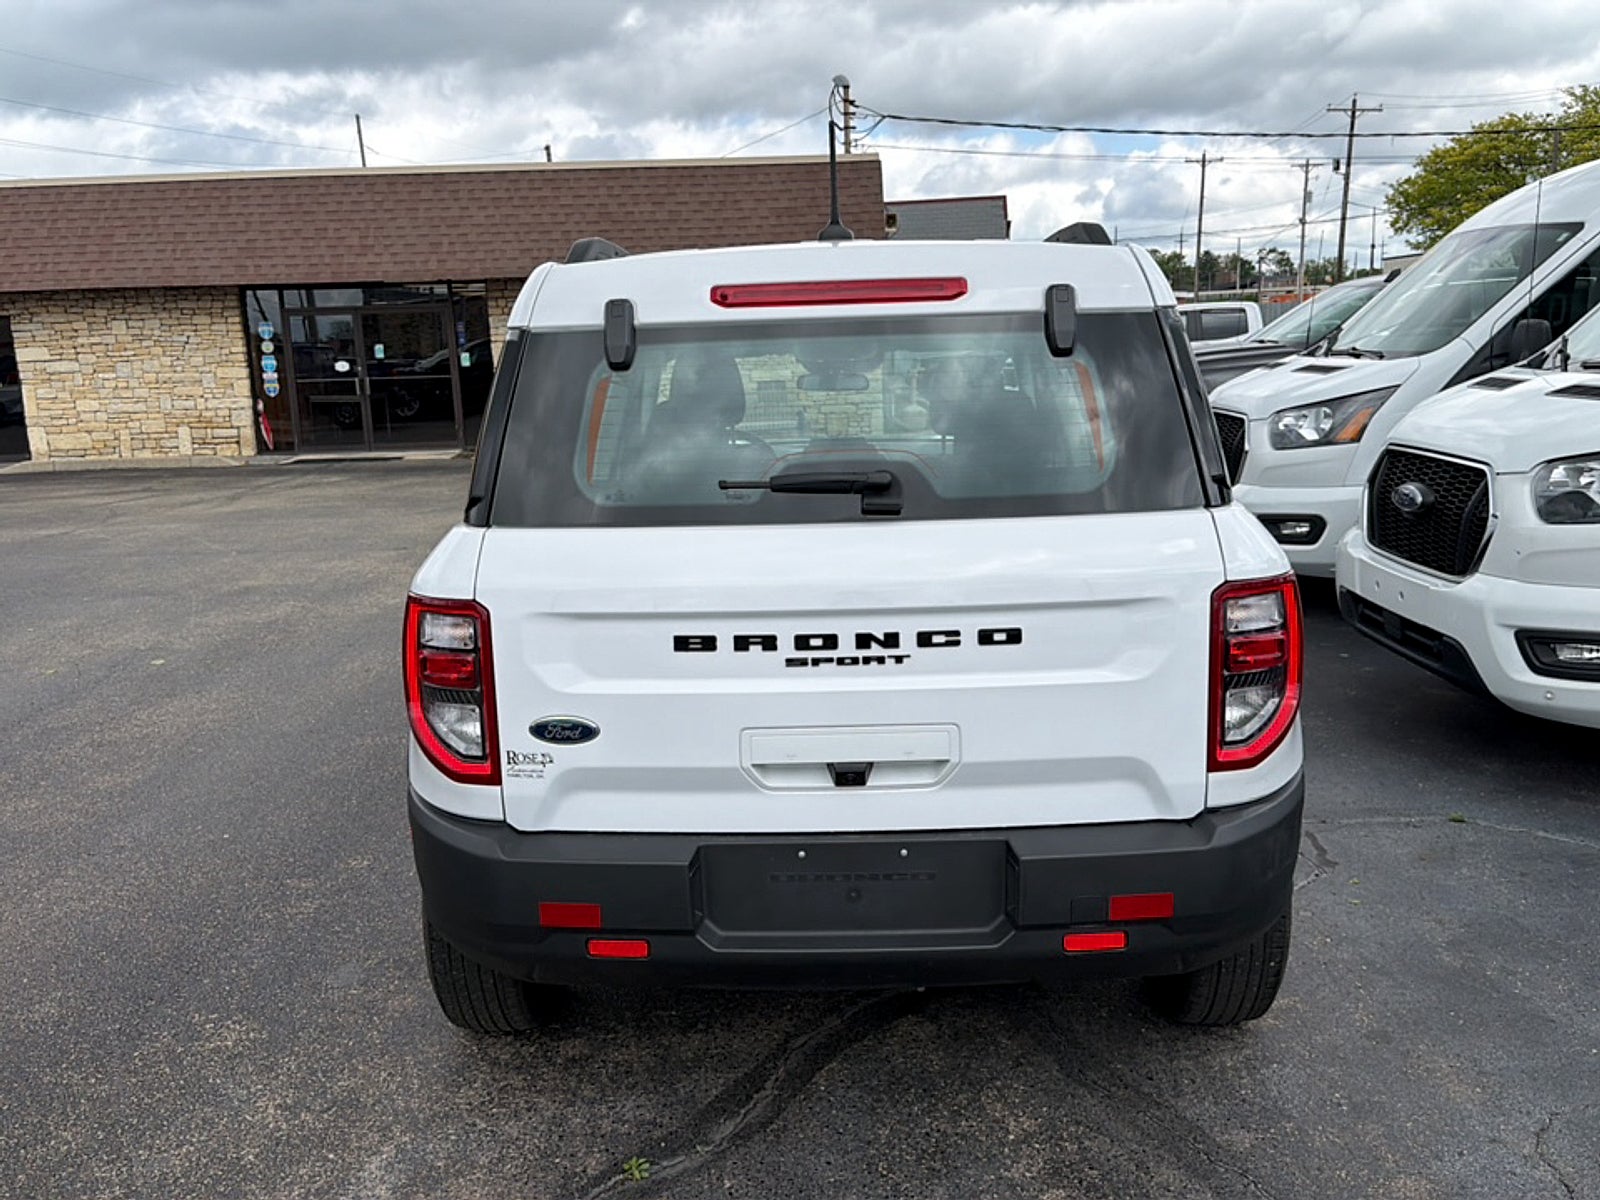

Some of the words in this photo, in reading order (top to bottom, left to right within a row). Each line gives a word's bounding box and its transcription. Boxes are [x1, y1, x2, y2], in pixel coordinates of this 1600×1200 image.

[673, 627, 1022, 652] BRONCO
[784, 654, 911, 667] SPORT
[544, 722, 583, 738] Ford
